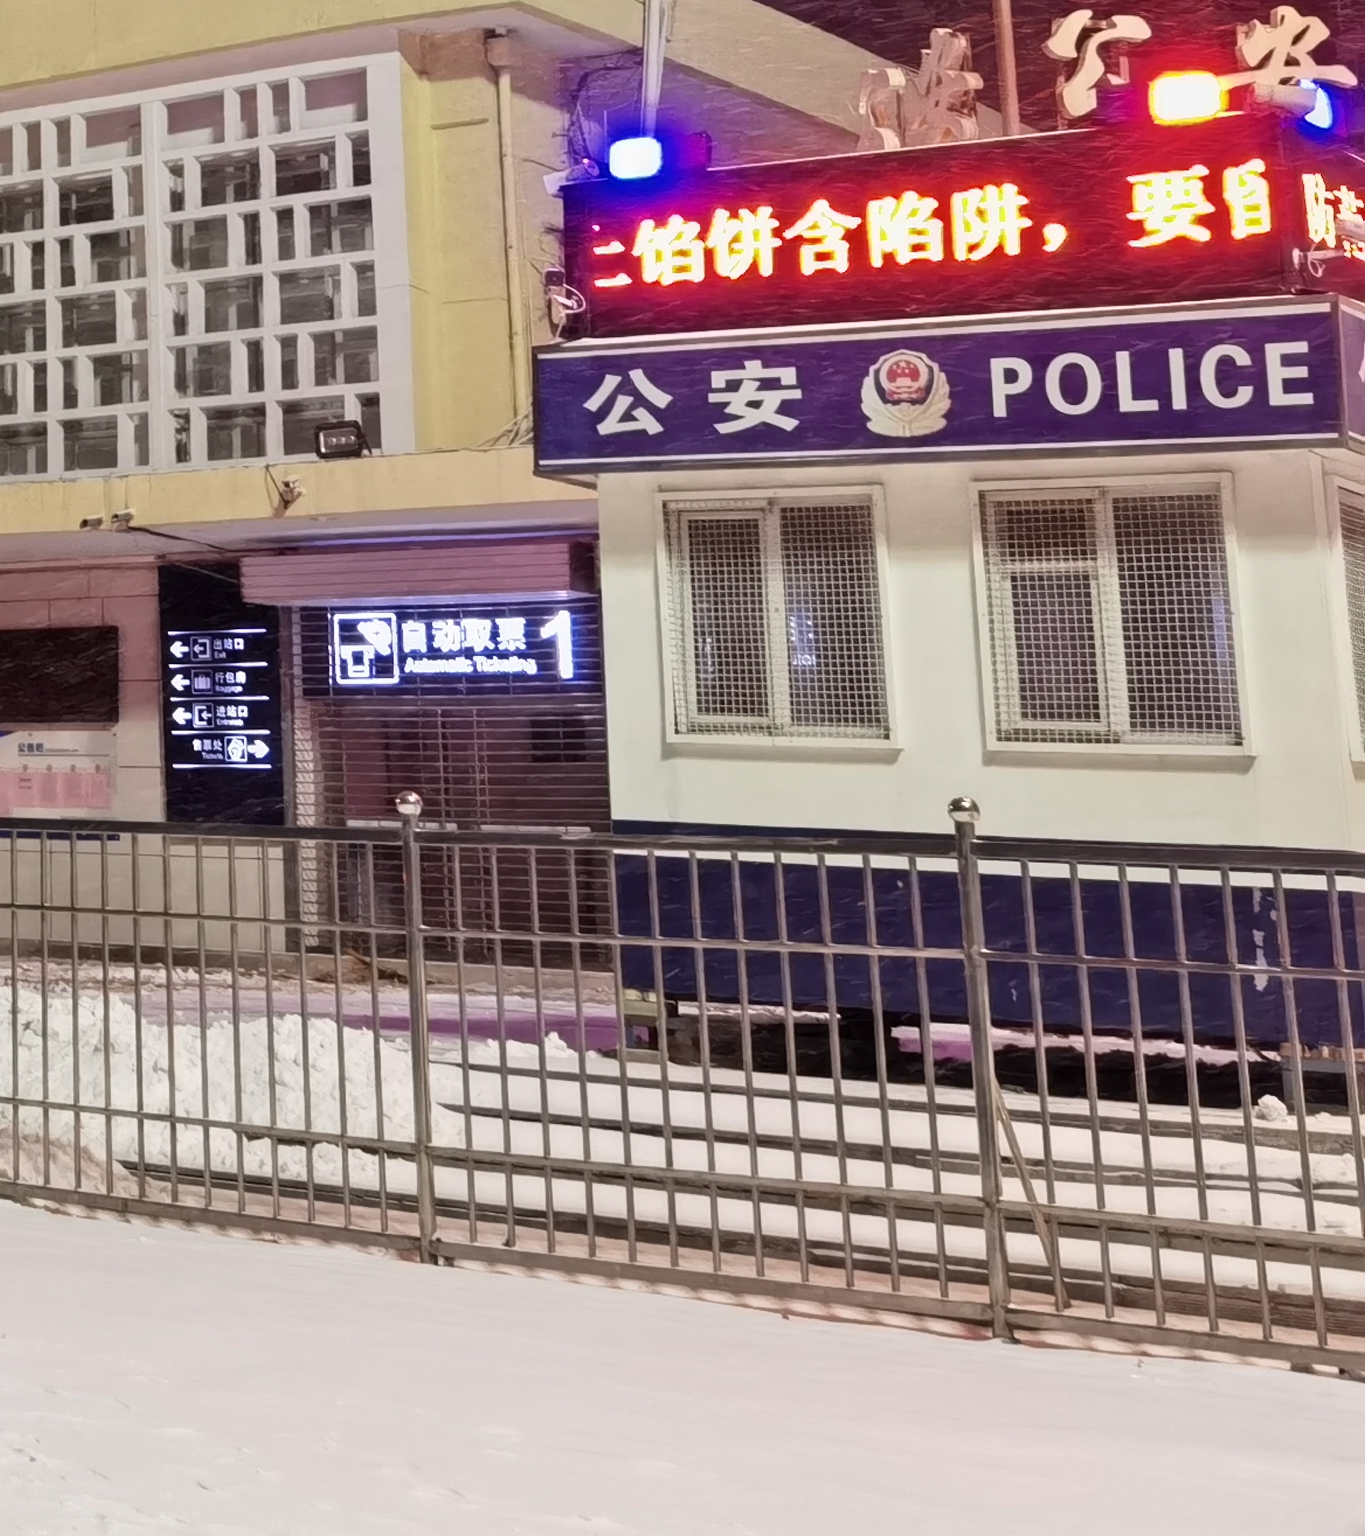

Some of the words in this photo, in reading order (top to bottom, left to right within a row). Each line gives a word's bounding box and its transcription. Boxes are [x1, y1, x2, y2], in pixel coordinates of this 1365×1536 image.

[583, 360, 803, 436] 公安
[990, 341, 1315, 418] POLICE
[402, 618, 527, 653] 自动取票
